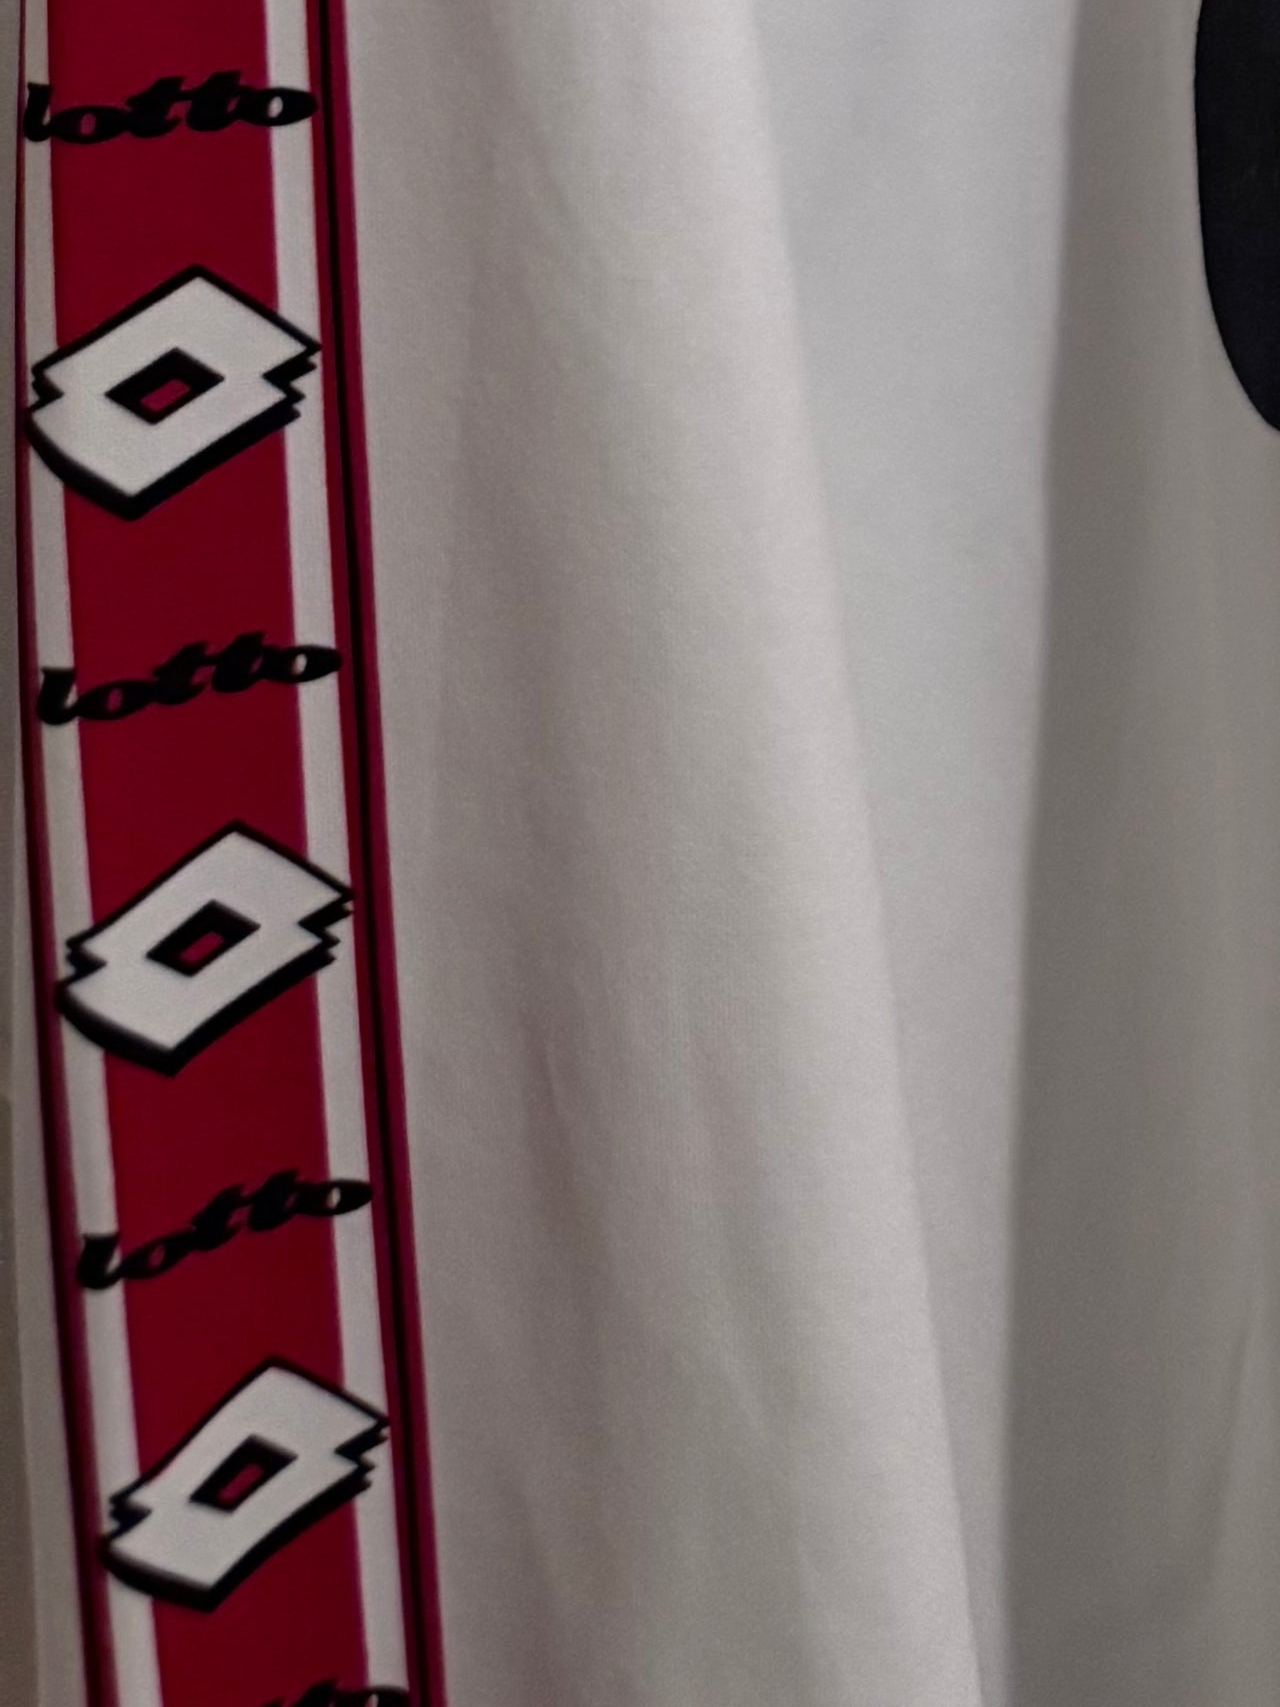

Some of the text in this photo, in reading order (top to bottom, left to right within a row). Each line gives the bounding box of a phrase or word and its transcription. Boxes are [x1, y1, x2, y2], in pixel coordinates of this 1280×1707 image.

[22, 69, 319, 146] lotto
[36, 630, 343, 726] lotto
[75, 1168, 373, 1291] lotto
